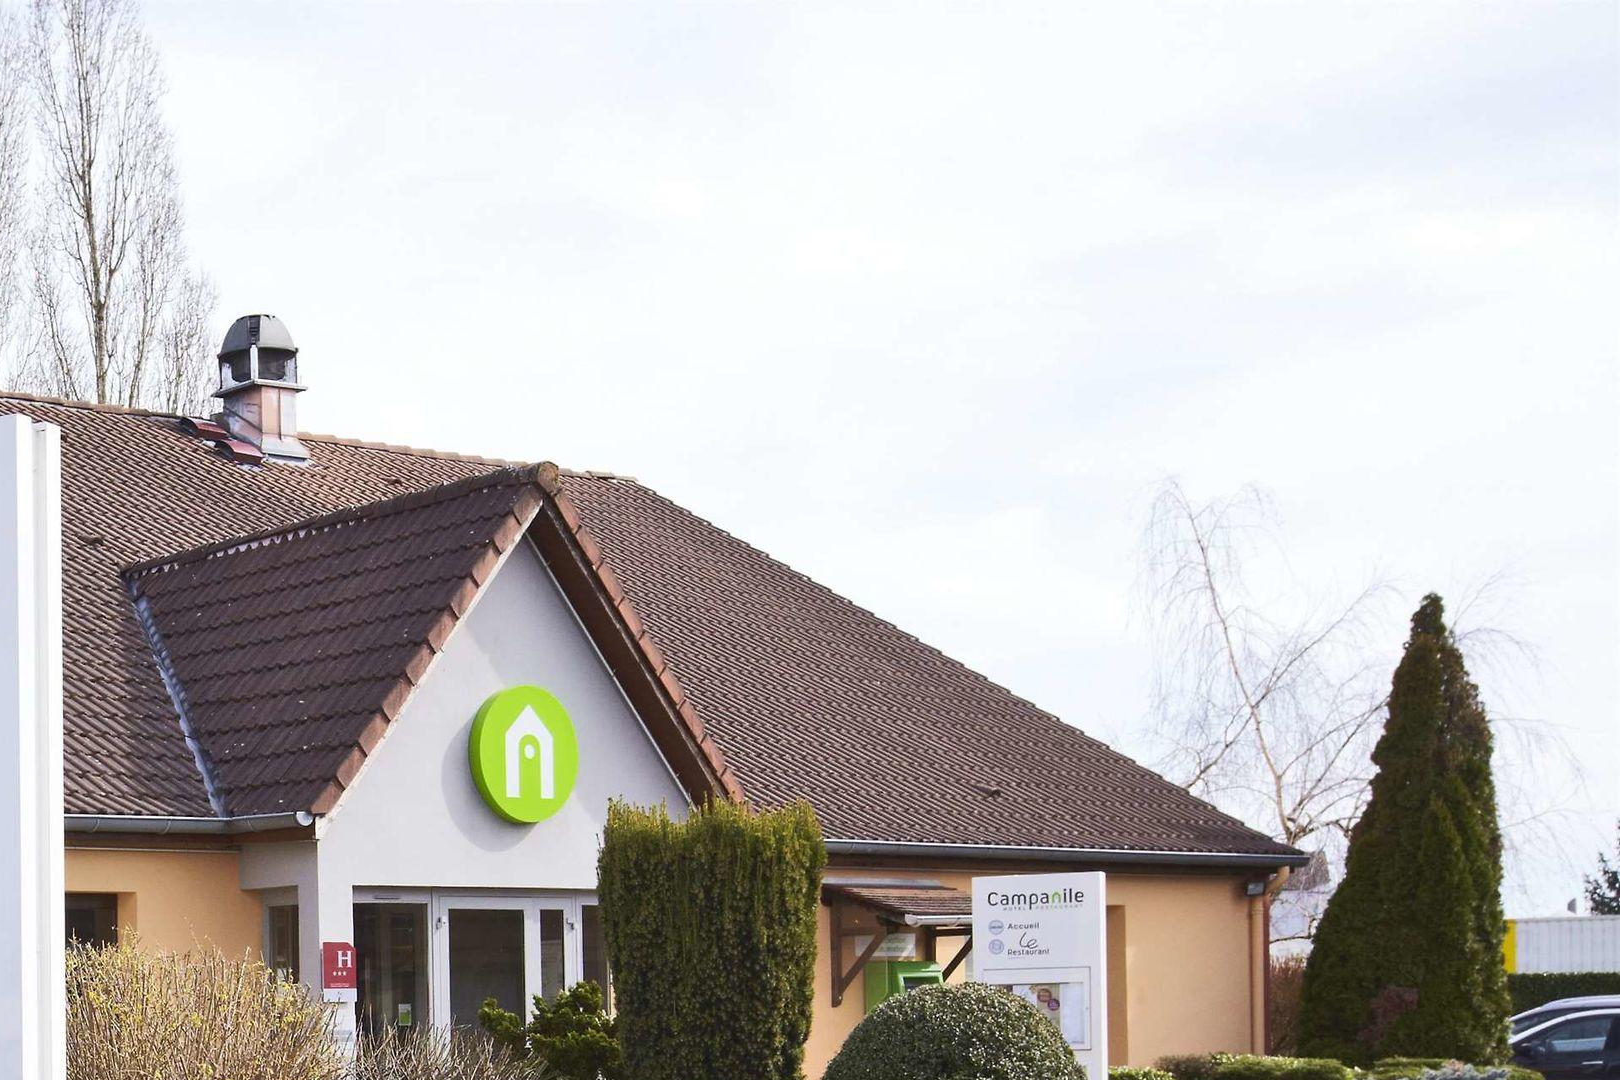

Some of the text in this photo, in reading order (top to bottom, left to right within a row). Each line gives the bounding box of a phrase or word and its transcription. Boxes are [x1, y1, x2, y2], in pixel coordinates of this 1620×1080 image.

[987, 888, 1085, 910] Campanile
[1007, 922, 1040, 930] Accueil
[1007, 948, 1050, 956] Restaurant
[337, 951, 352, 968] H
